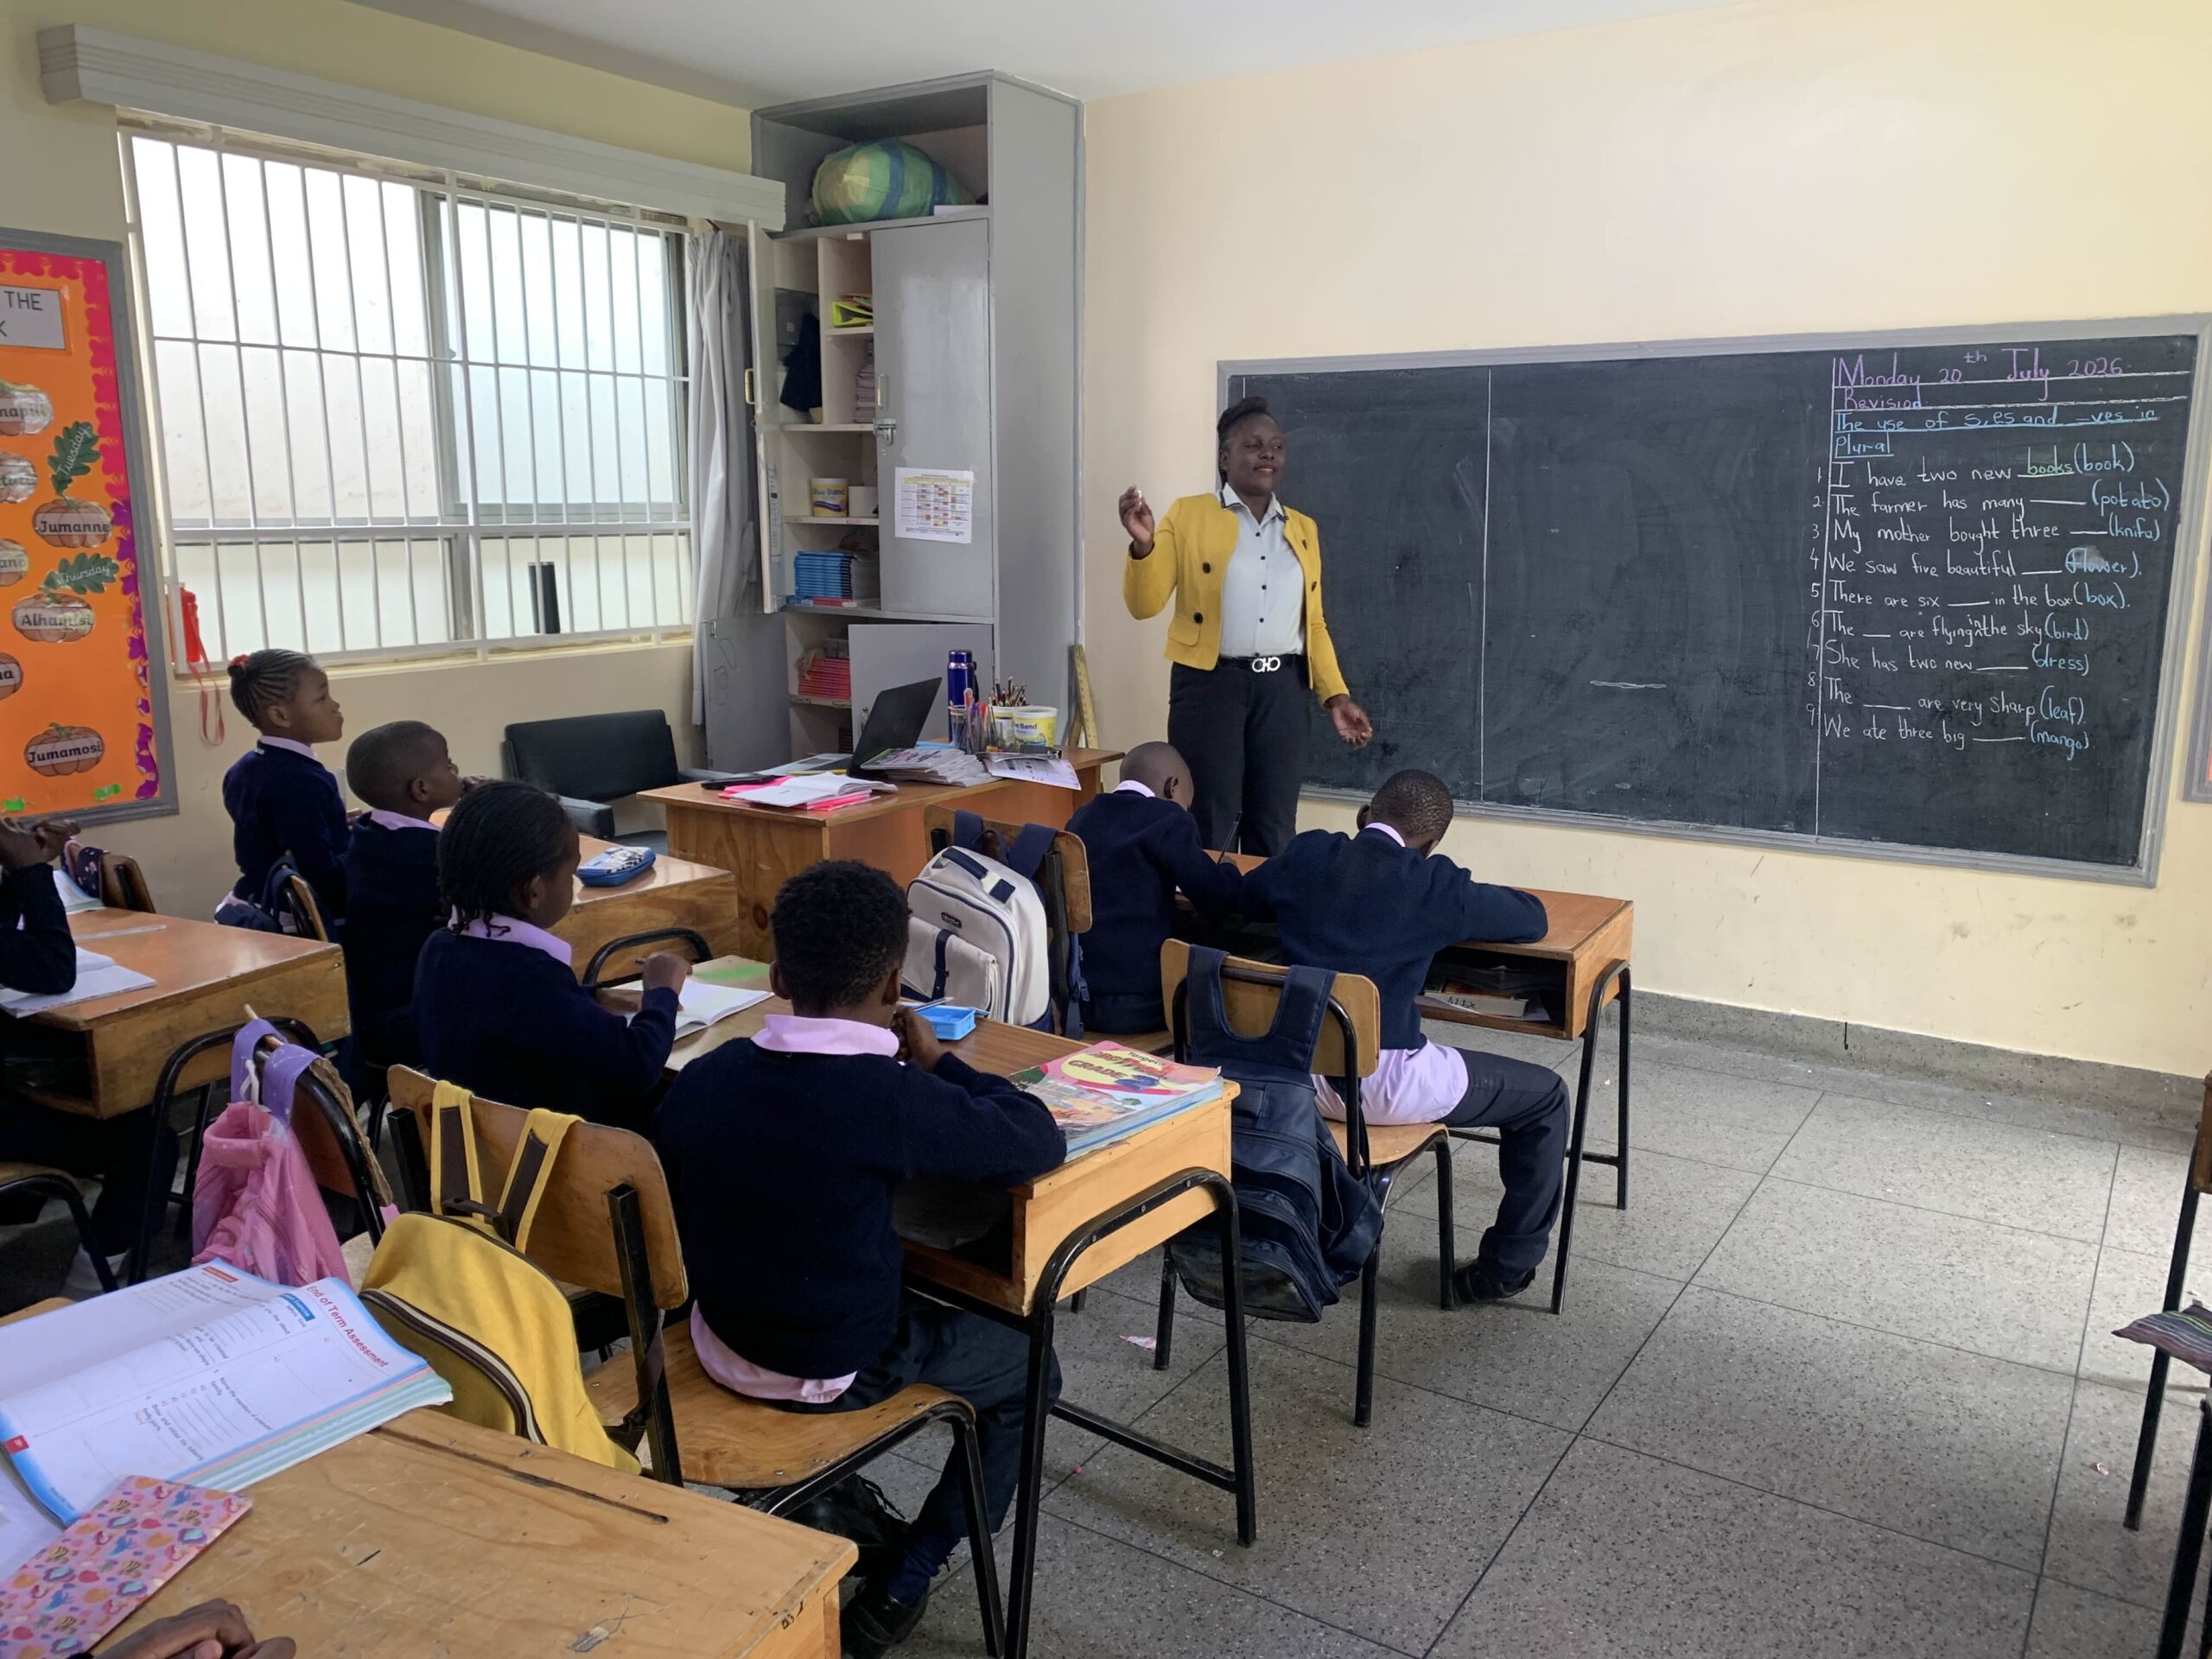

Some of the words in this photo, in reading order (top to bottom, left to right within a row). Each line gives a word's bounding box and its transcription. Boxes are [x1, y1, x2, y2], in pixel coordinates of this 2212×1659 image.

[3, 290, 43, 311] THE
[1839, 352, 1920, 401] Monday
[1939, 368, 1962, 383] 20
[1963, 350, 1987, 364] th
[2001, 347, 2050, 402] July
[2067, 357, 2123, 378] 2026
[1844, 387, 1922, 410] Revision
[1834, 412, 1865, 431] The
[1925, 410, 1949, 429] of
[2023, 405, 2058, 425] and
[2136, 405, 2155, 421] in
[54, 426, 92, 476] Tuesday
[1834, 432, 1891, 458] Plural
[1829, 461, 1854, 488] I
[1867, 461, 1907, 486] have
[1917, 455, 1958, 482] two
[1972, 468, 2012, 480] new
[2027, 445, 2073, 474] books
[2074, 442, 2134, 474] (book)
[1831, 493, 1859, 517] The
[1872, 492, 1928, 512] farmer
[1943, 489, 1967, 510] has
[1983, 497, 2024, 522] many
[2092, 478, 2170, 517] (potato)
[39, 520, 111, 533] Jumanne
[1812, 524, 1820, 538] 3
[1834, 519, 1861, 554] My
[1878, 517, 1930, 543] mother
[1950, 516, 1999, 555] bought
[2012, 512, 2060, 539] three
[60, 564, 111, 583] Thursday
[1810, 548, 1819, 570] 4
[1828, 552, 1856, 572] We
[1866, 561, 1897, 575] saw
[1912, 553, 1939, 577] five
[1948, 549, 2016, 577] beautiful
[1811, 582, 1821, 597] 5
[1828, 579, 1872, 604] There
[1884, 598, 1908, 607] are
[1918, 596, 1940, 607] six
[1992, 592, 2005, 605] in
[2012, 584, 2037, 605] the
[1811, 610, 1821, 627] 6
[1824, 610, 1854, 636] The
[1899, 629, 1924, 640] are
[1932, 615, 1974, 647] flying
[1980, 614, 2007, 637] the
[2018, 610, 2043, 646] sky
[2045, 613, 2089, 639] (bird)
[1825, 639, 1859, 669] She
[1872, 647, 1898, 671] has
[1909, 645, 1937, 669] two
[1945, 659, 1973, 671] new
[2032, 643, 2088, 677] (dress)
[1808, 671, 1816, 687] 8
[1824, 676, 1853, 704] The
[1918, 698, 1944, 711] are
[1953, 698, 1982, 726] very
[1806, 703, 1815, 726] 9
[1824, 713, 1851, 738] We
[1863, 714, 1887, 740] ate
[1898, 715, 1933, 739] three
[1942, 719, 1965, 751] big
[28, 741, 102, 763] Jumamosi
[1068, 1060, 1128, 1079] GRADE
[307, 1286, 325, 1298] End
[320, 1297, 333, 1306] of
[328, 1306, 347, 1328] Term
[344, 1328, 389, 1368] Assessment
